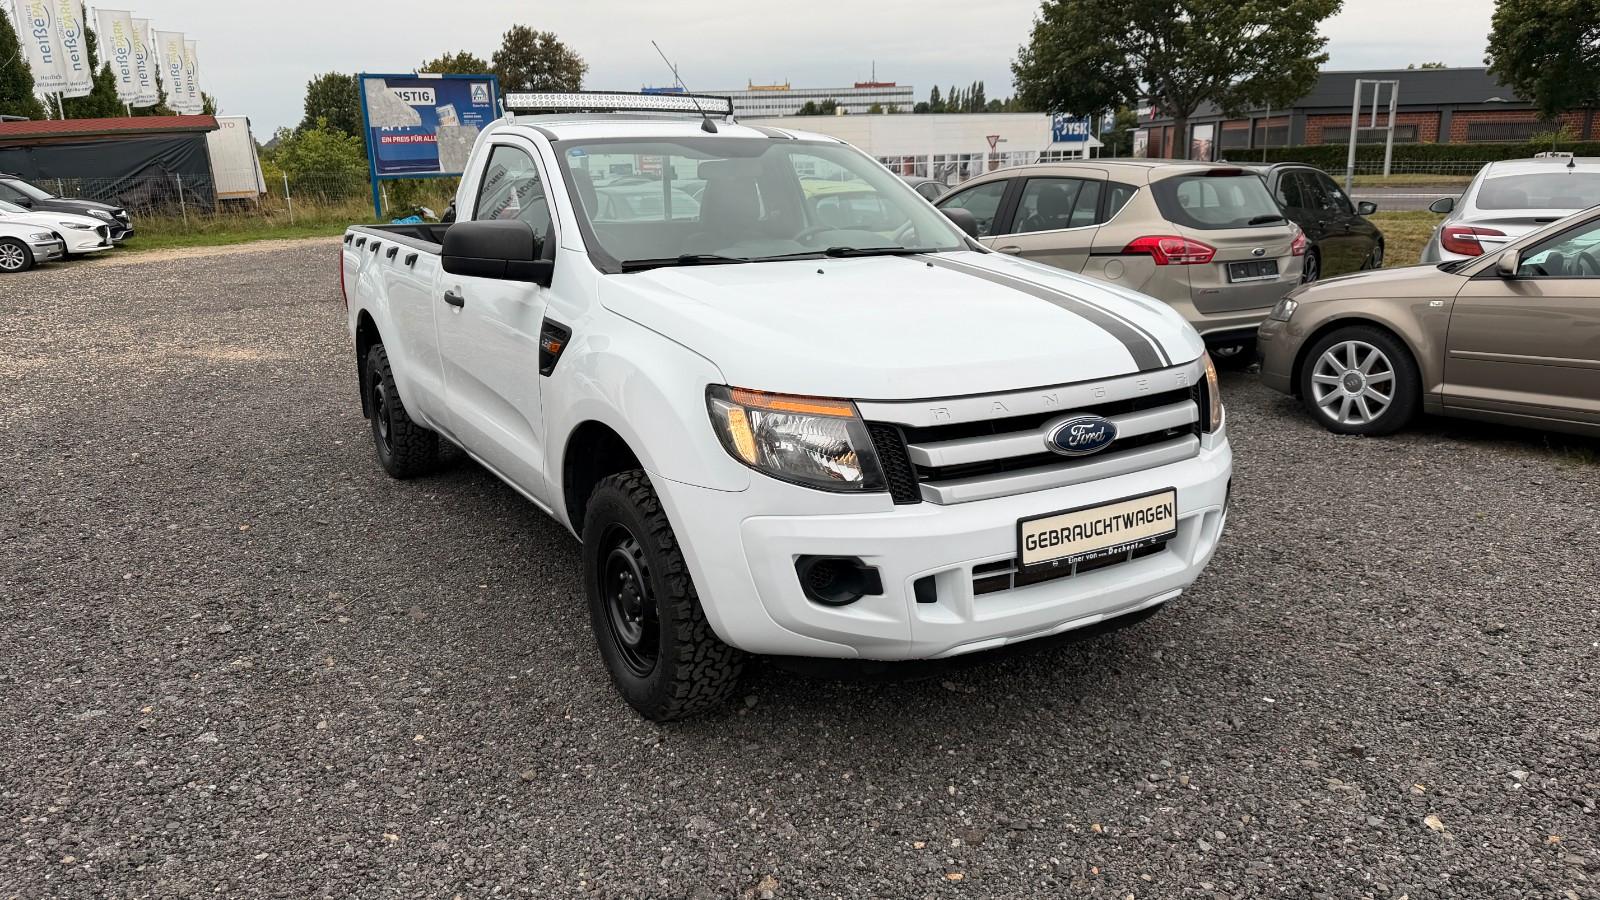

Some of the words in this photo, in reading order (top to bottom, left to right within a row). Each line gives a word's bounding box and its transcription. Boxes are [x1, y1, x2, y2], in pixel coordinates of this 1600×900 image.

[32, 0, 52, 64] neißePA
[411, 134, 422, 142] FÜR
[1061, 122, 1088, 135] JYSK
[929, 372, 1189, 420] RANGER
[1069, 424, 1106, 448] Ford
[1025, 502, 1173, 551] GEBRAUCHTWAGEN
[1068, 556, 1084, 564] Einer
[1086, 552, 1098, 560] von
